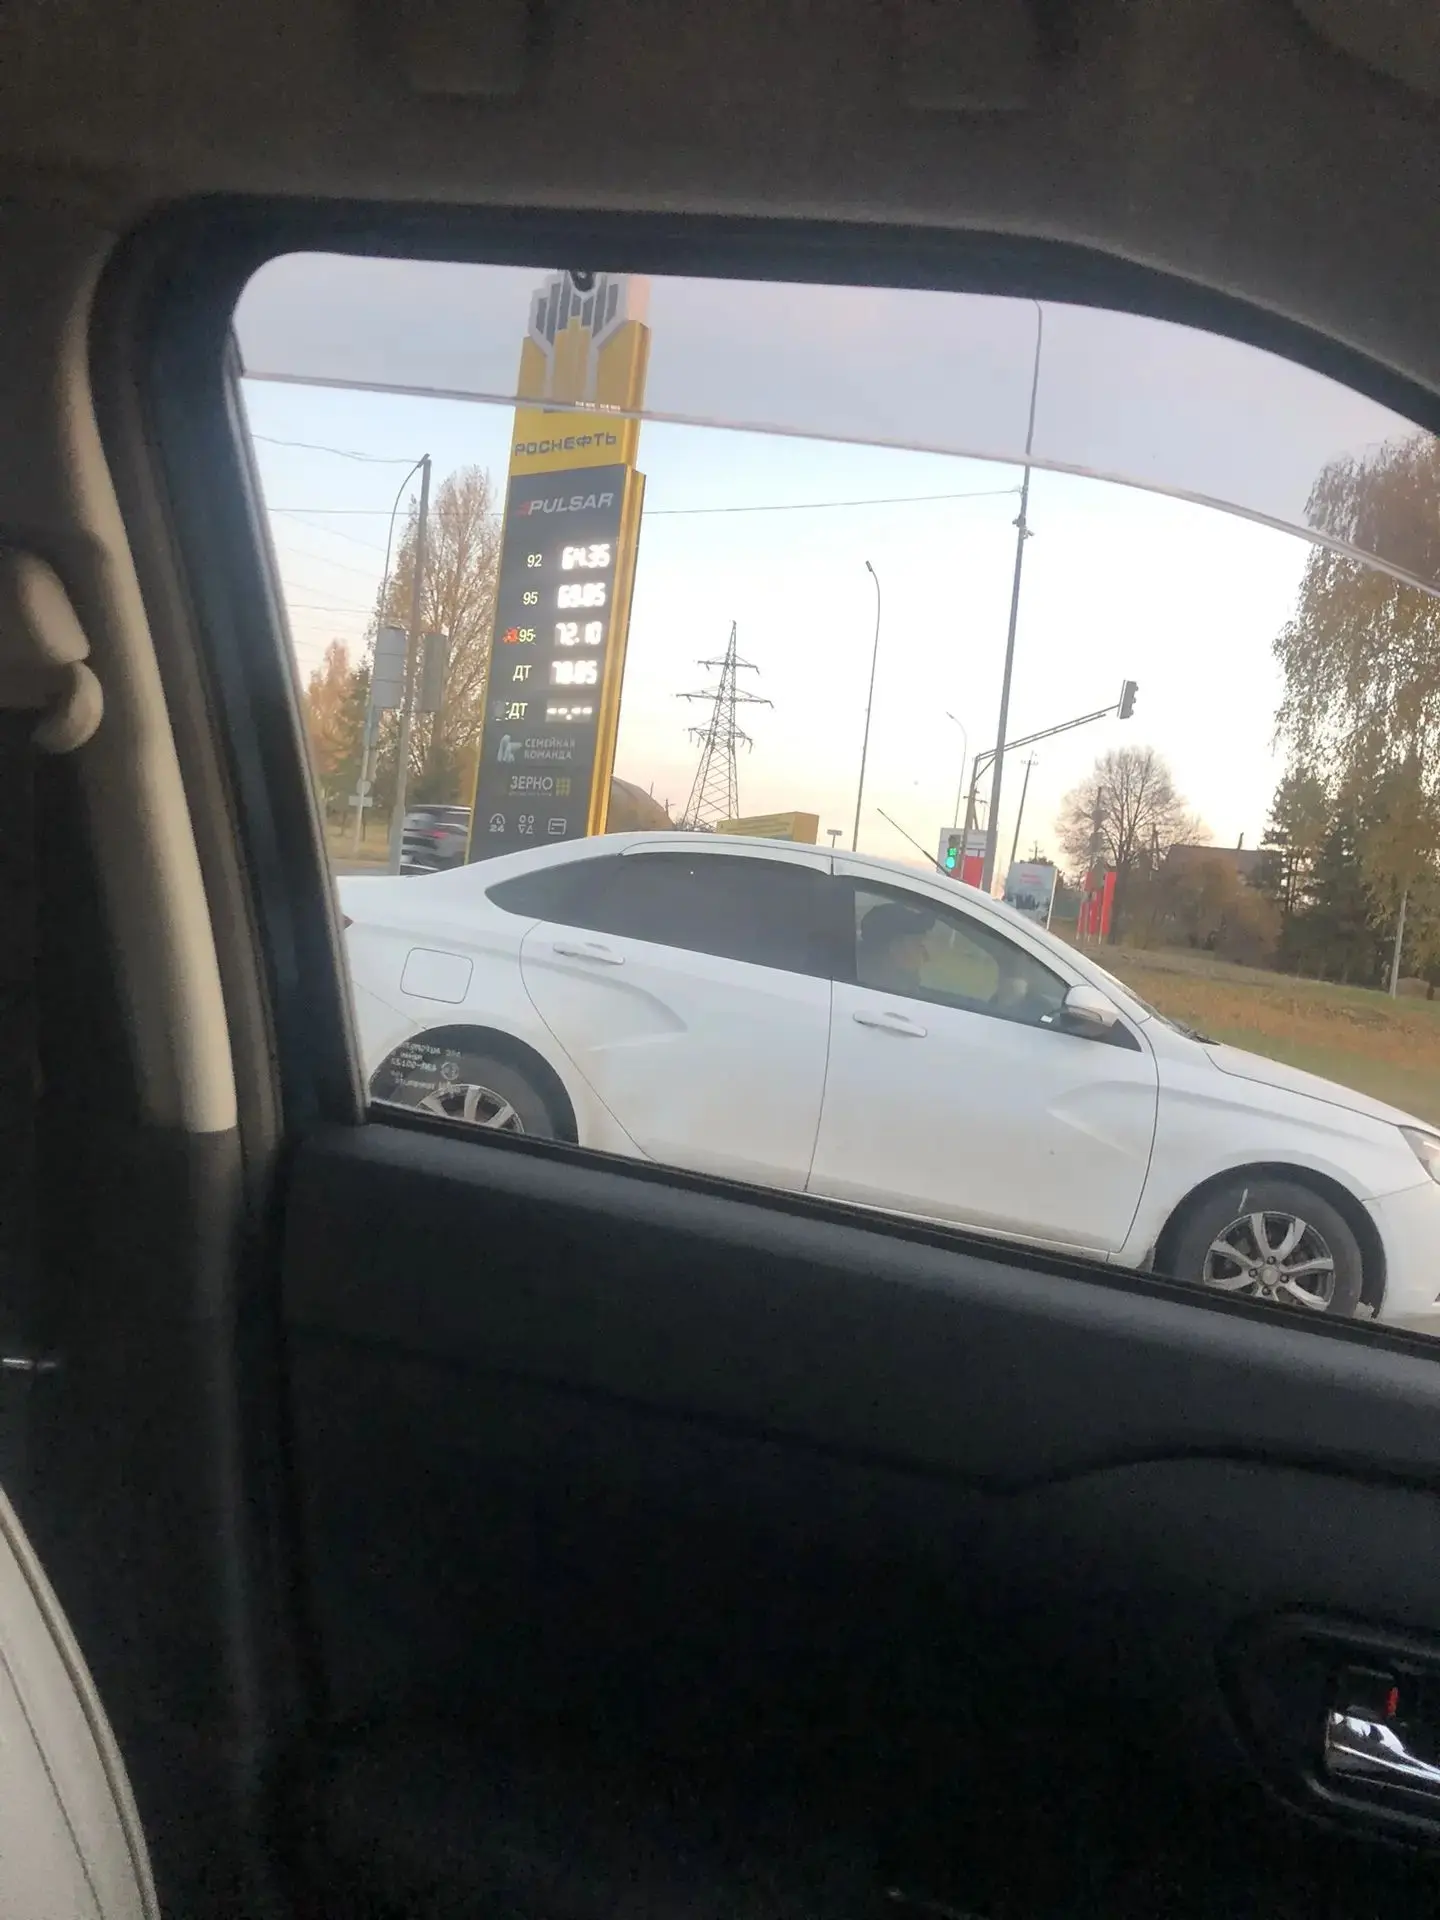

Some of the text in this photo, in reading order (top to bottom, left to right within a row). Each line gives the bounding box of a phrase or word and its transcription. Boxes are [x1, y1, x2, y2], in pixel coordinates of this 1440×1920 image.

[515, 431, 616, 456] РОСНЕФТЬ
[528, 492, 614, 516] PULSAR
[527, 553, 542, 568] 92
[523, 591, 538, 605] 95
[519, 628, 534, 642] 95
[512, 665, 532, 682] ДТ
[508, 702, 529, 720] ДТ
[524, 737, 576, 749] СЕМЕЙНАЯ
[524, 749, 573, 760] КОМАНДА
[510, 776, 553, 791] ЗЕРНО
